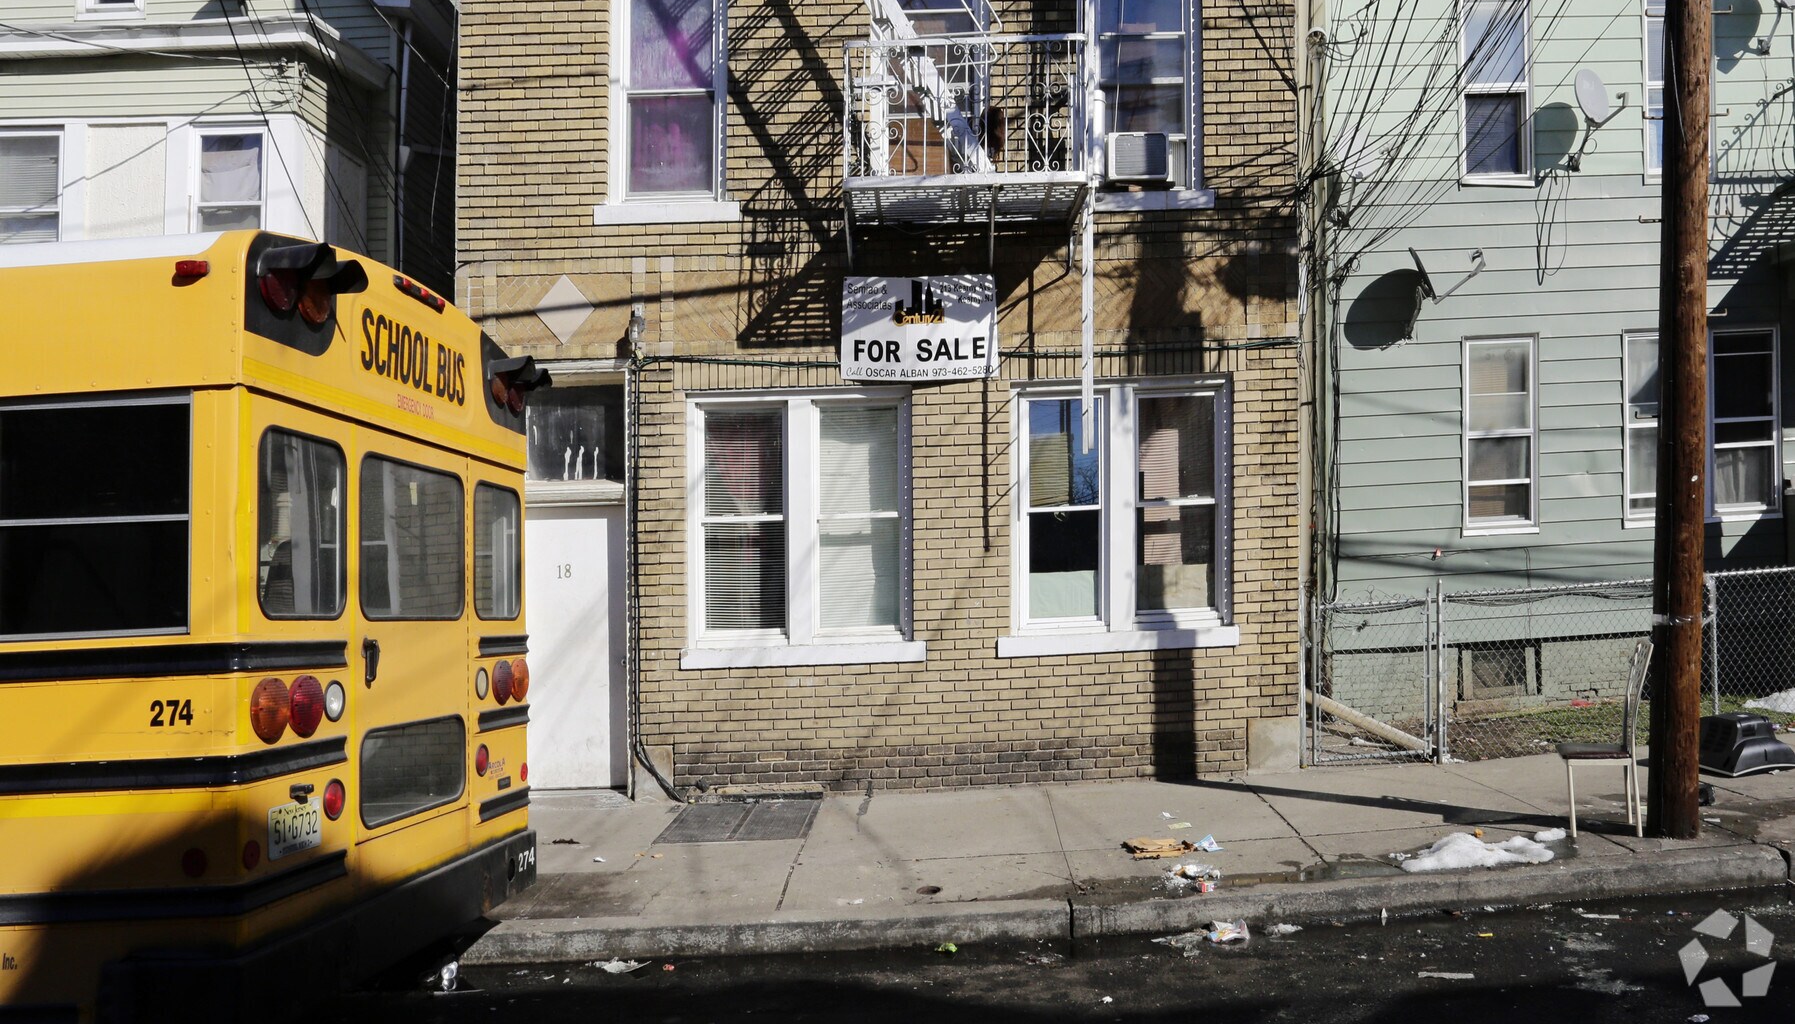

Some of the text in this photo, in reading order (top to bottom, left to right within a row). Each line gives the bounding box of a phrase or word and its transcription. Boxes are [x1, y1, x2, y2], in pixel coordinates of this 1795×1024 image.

[881, 284, 888, 295] &
[846, 299, 893, 311] Associates
[361, 308, 465, 406] SCHOOL BUS
[853, 336, 985, 363] FOR SALE
[846, 365, 994, 378] Call OSCAR ALBAN 973-462-5280
[556, 563, 572, 580] 18
[150, 699, 194, 727] 274
[518, 847, 535, 873] 274
[1, 953, 18, 970] Inc.
